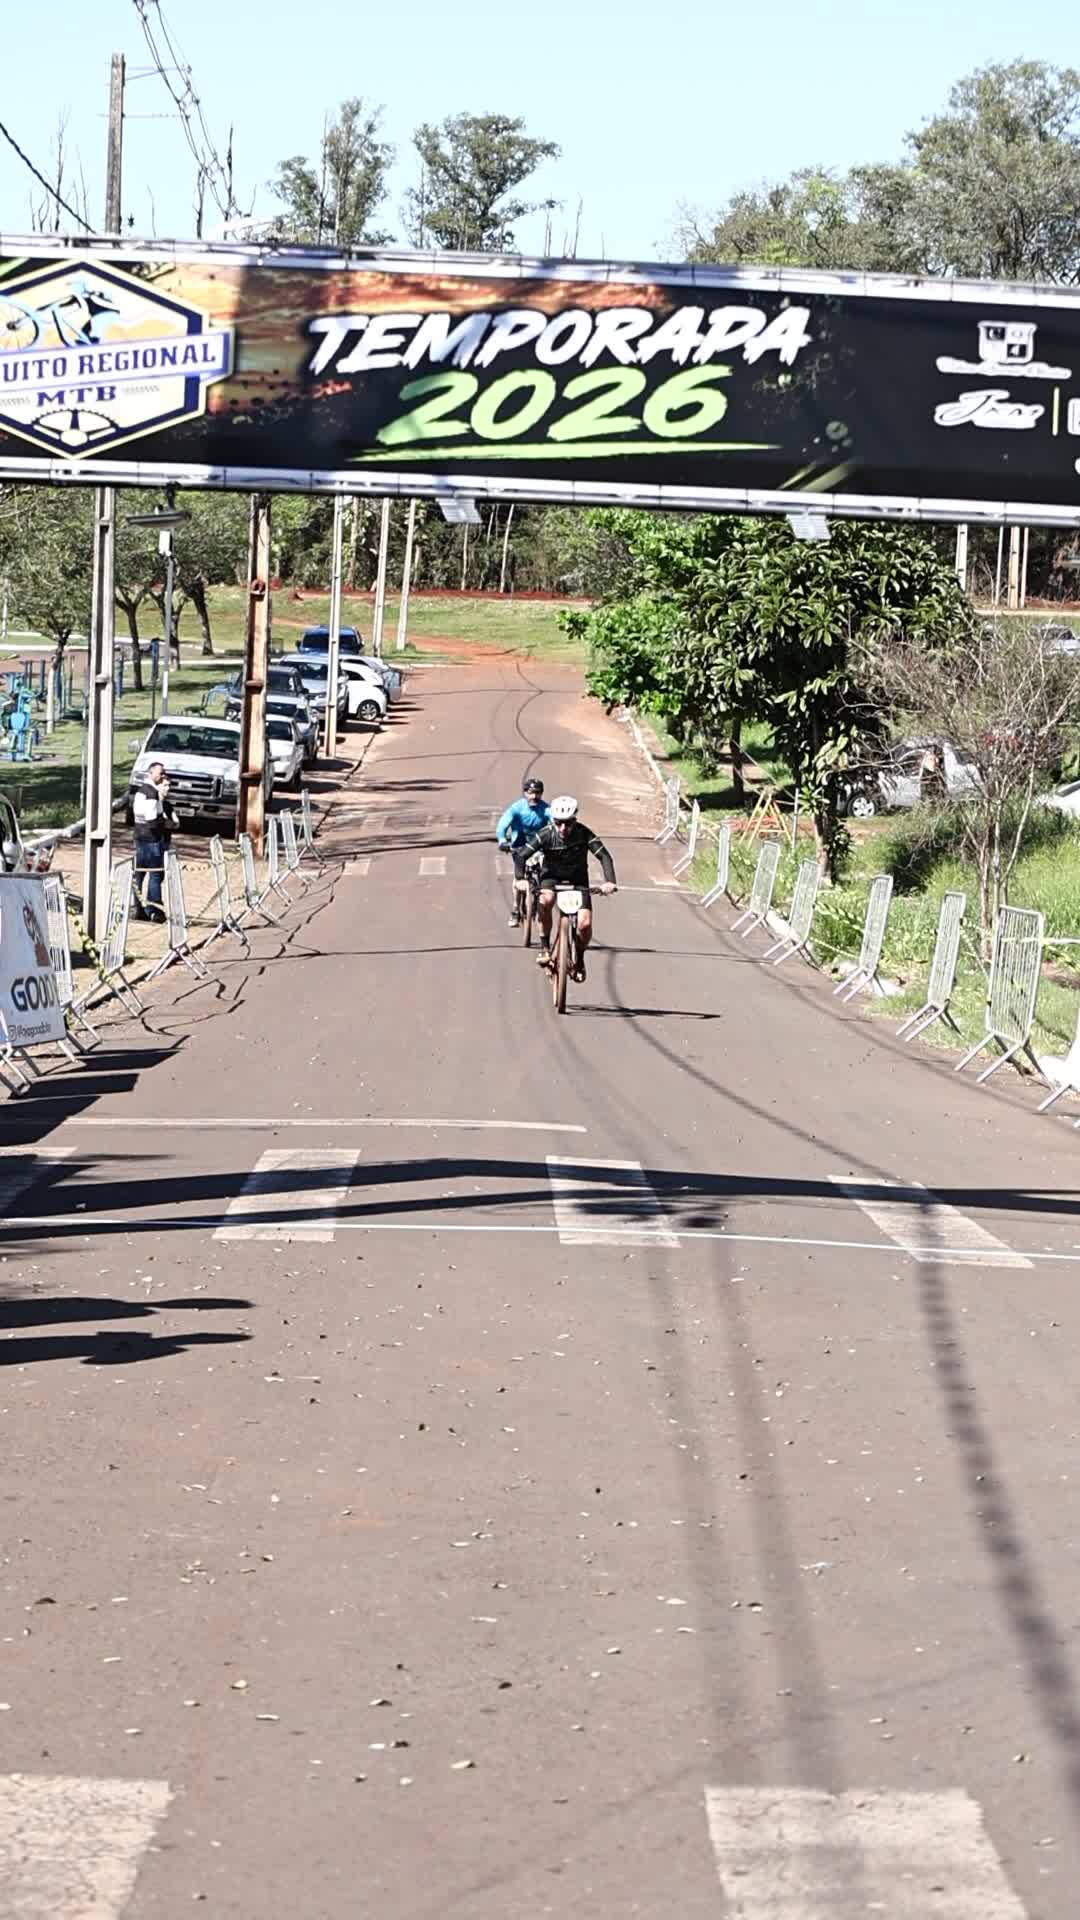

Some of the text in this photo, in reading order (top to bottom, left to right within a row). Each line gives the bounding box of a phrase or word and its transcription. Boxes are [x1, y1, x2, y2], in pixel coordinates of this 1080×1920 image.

[78, 343, 216, 375] REGIONAL
[37, 386, 117, 407] MTB
[376, 365, 733, 446] 2026
